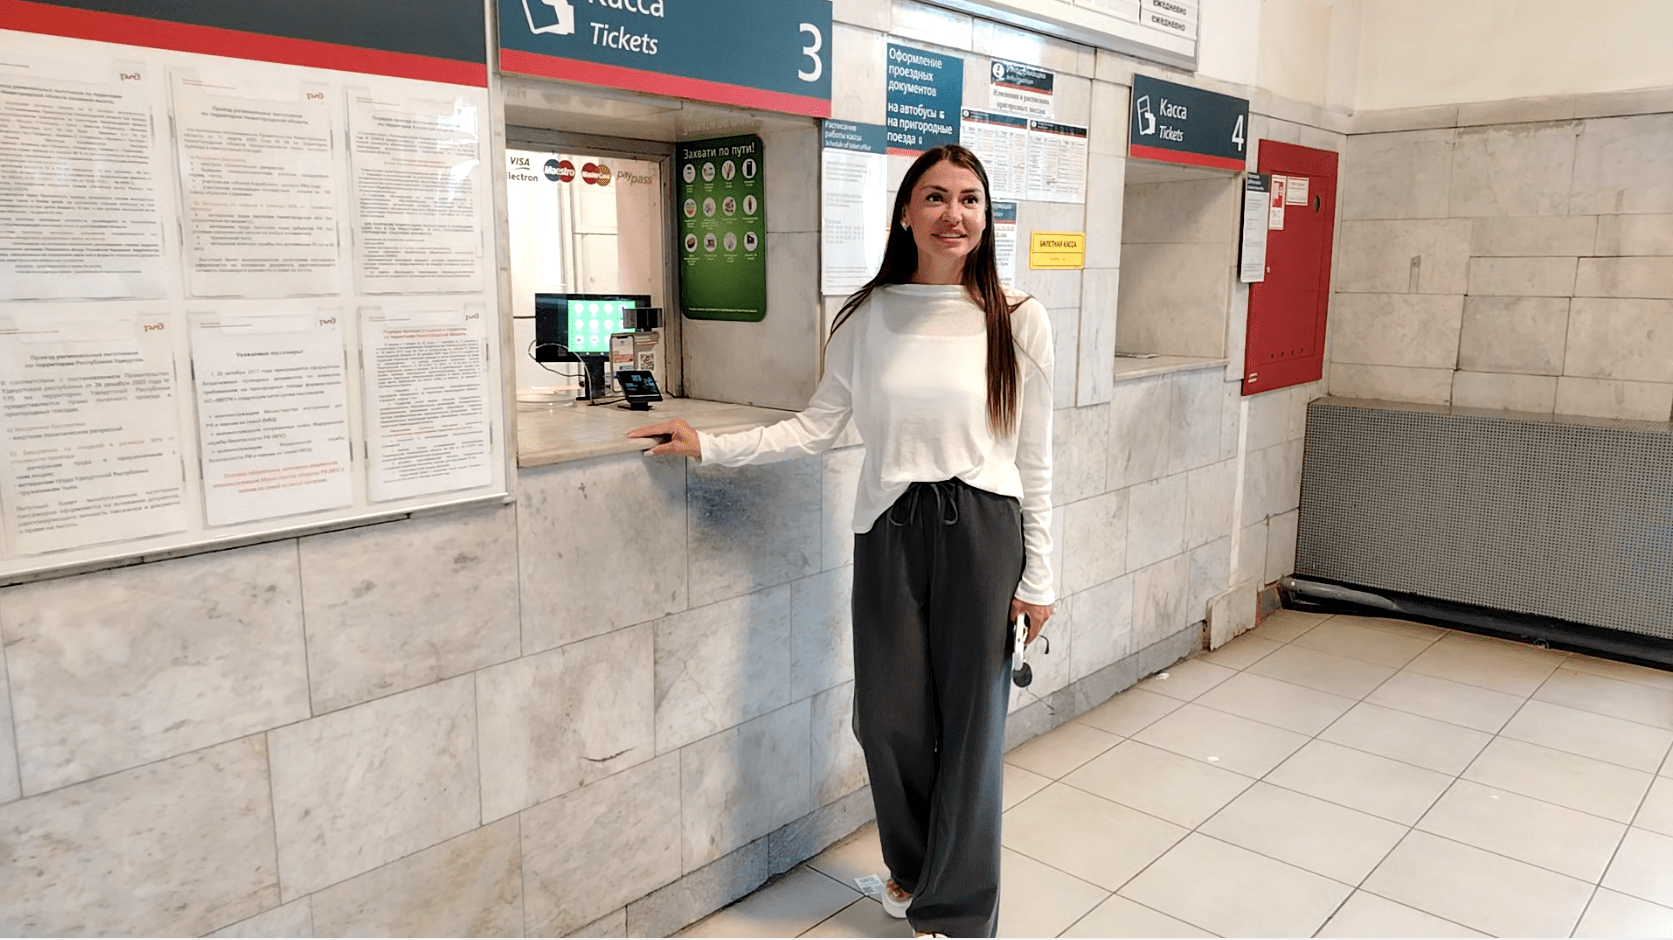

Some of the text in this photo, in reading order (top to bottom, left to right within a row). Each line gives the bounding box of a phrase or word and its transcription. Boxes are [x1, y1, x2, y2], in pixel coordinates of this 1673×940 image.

[1151, 15, 1186, 31] ежедневно
[590, 22, 658, 55] Tickets
[798, 23, 823, 82] 3
[889, 47, 943, 69] Оформление
[888, 65, 934, 81] проездных
[888, 80, 937, 97] документов
[888, 102, 937, 120] на автобусы
[1160, 98, 1187, 120] Касса
[887, 117, 953, 135] на пригородные
[1159, 125, 1184, 142] Tickets
[1231, 115, 1245, 152] 4
[887, 132, 916, 146] поезда
[683, 142, 755, 160] Захвати по пути!
[510, 157, 530, 166] VISA
[544, 165, 575, 177] Maestro
